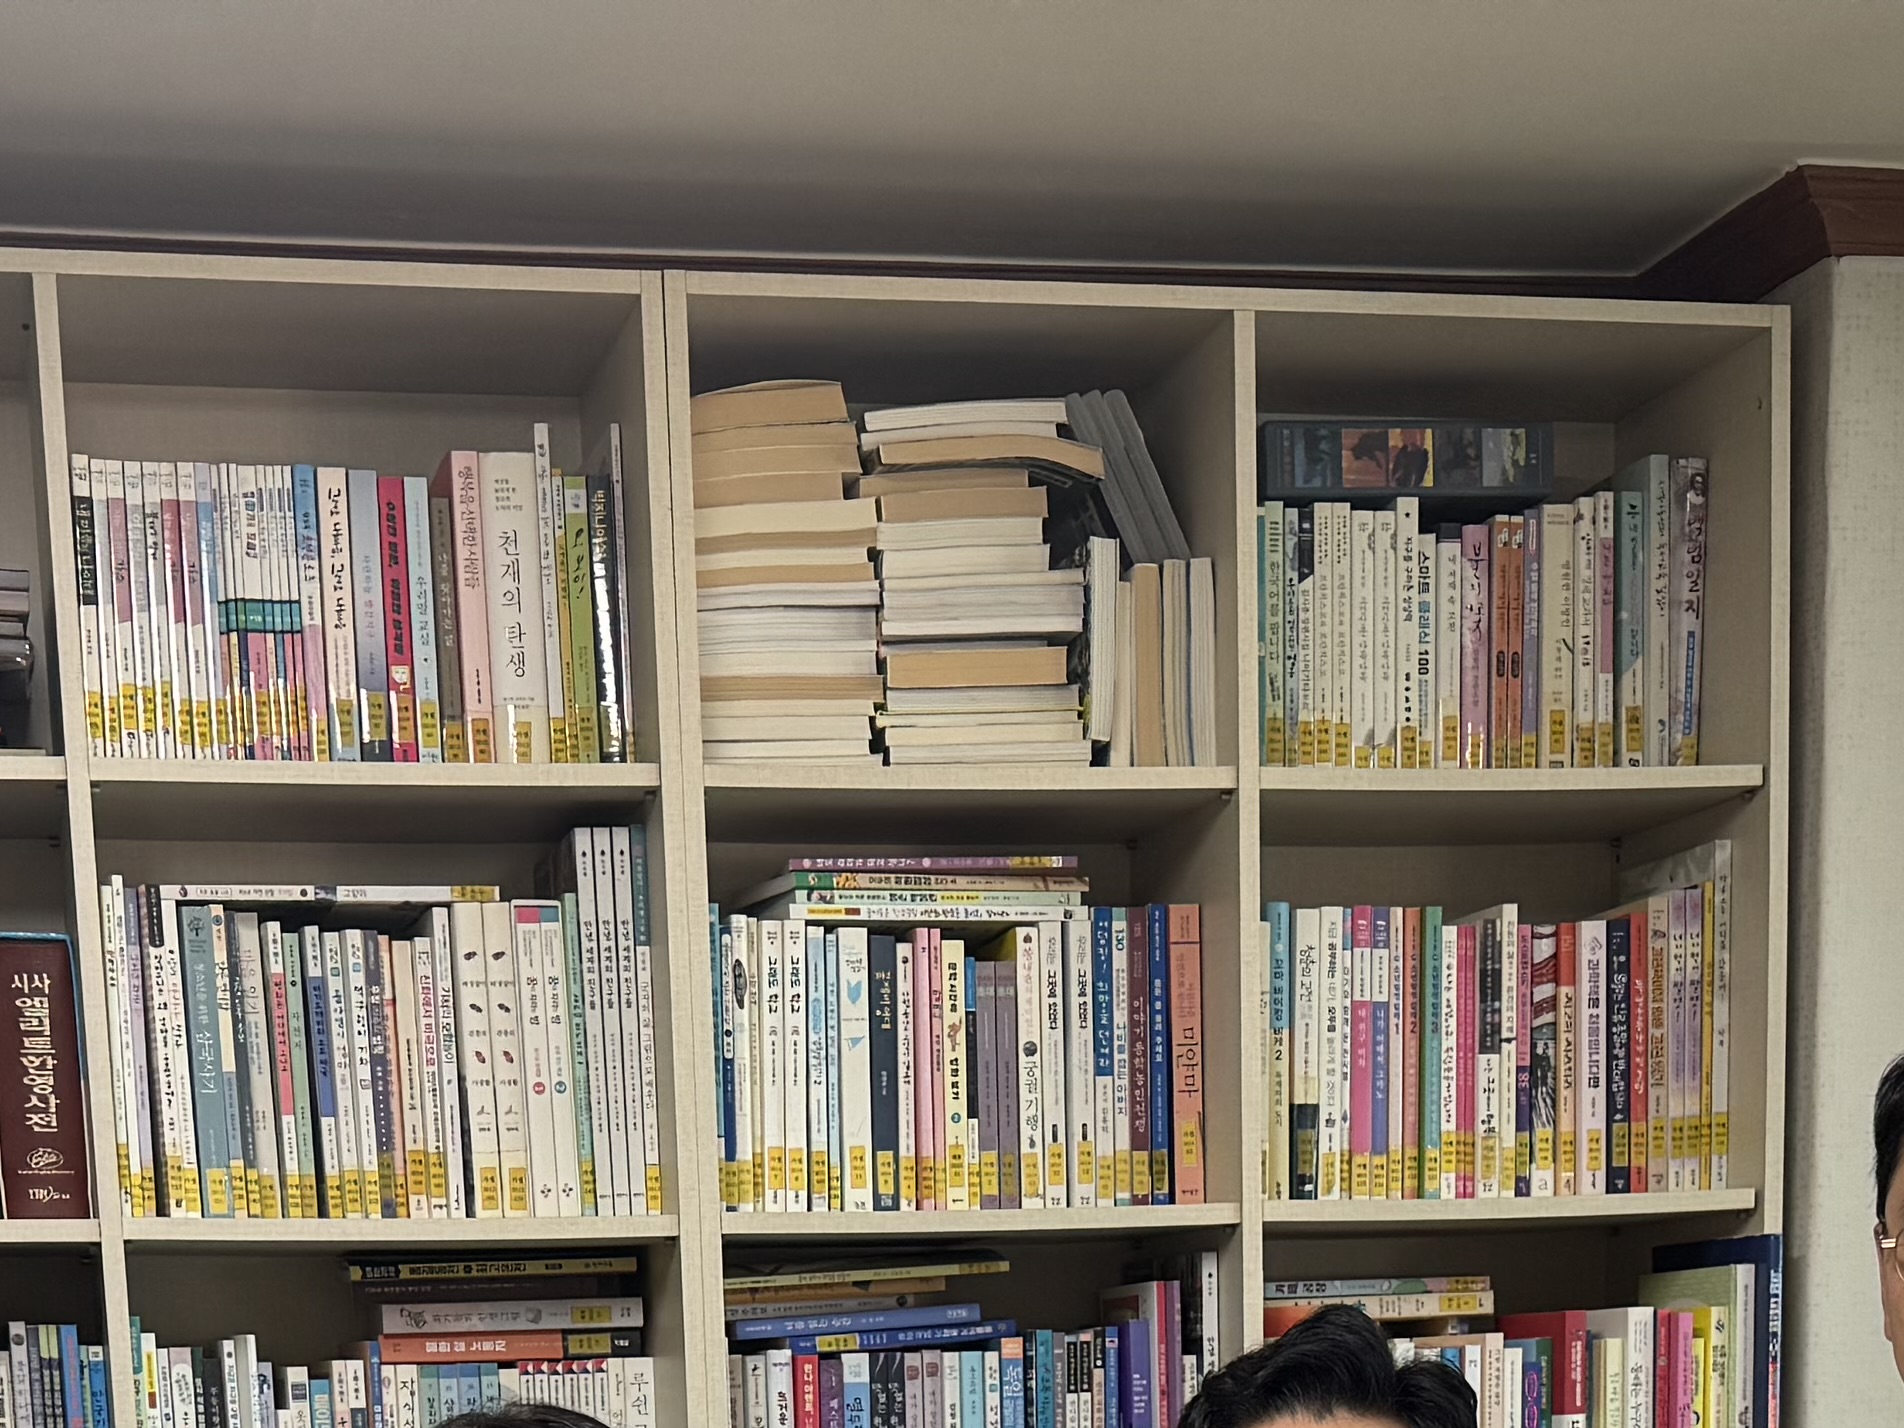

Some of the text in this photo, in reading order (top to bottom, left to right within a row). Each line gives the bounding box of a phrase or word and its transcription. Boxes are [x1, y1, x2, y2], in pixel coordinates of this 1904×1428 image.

[462, 549, 479, 590] 사람들
[498, 529, 526, 678] 천재의 탄생
[1417, 551, 1430, 676] 스마트 클래식 100
[1273, 958, 1283, 981] 꼬마
[1300, 944, 1316, 1002] 청춘의 고전
[1328, 941, 1338, 979] 공부하는
[1273, 985, 1284, 1021] 바이킹
[1587, 958, 1600, 1089] 과학책은 처음입니다만
[198, 1030, 217, 1094] 삼국사기
[1176, 1027, 1199, 1099] 미얀마
[1004, 1365, 1023, 1398] 독일
